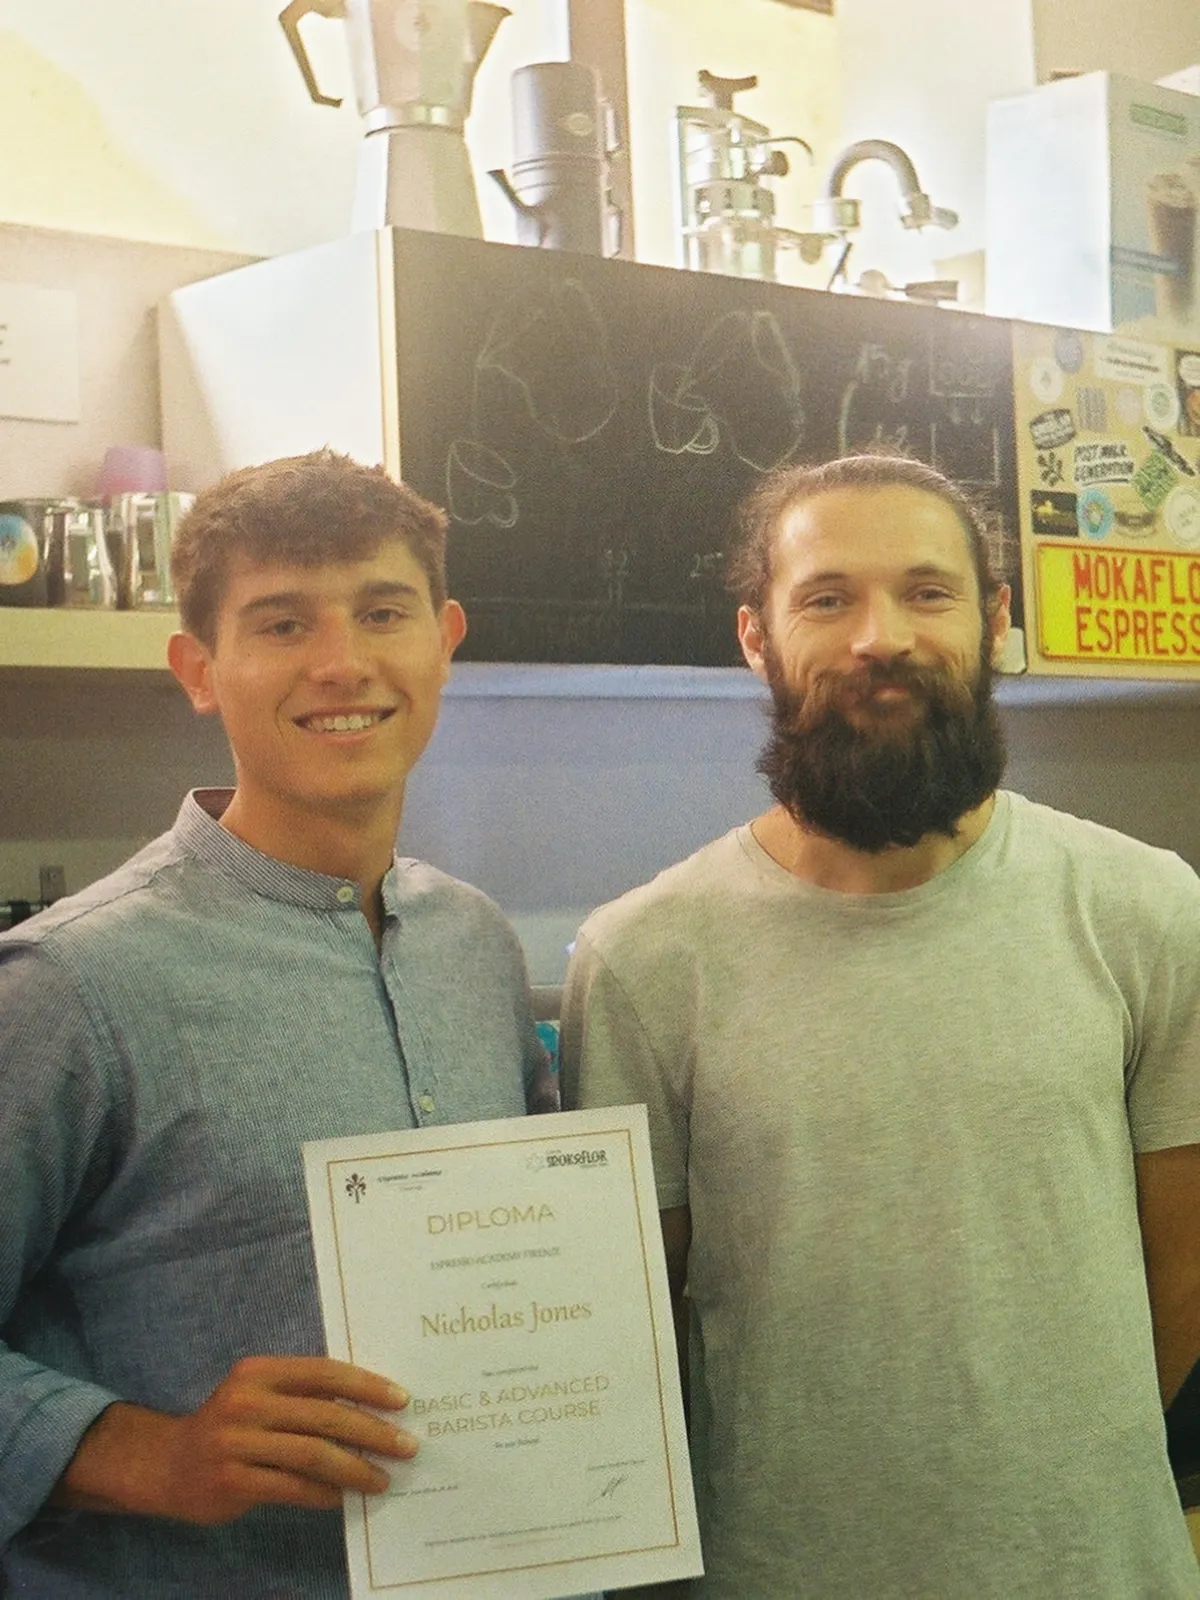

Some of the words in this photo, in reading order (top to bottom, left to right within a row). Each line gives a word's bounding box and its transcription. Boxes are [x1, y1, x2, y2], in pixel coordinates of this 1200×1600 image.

[1073, 552, 1200, 606] MOKAFLO
[427, 1203, 556, 1235] DIPLOMA
[420, 1303, 524, 1337] Nicholas
[528, 1301, 592, 1333] Jones
[412, 1392, 472, 1416] BASIC
[479, 1390, 492, 1408] &
[498, 1375, 611, 1403] ADVANCED
[427, 1412, 513, 1438] BARISTA
[518, 1400, 602, 1425] COURSE
